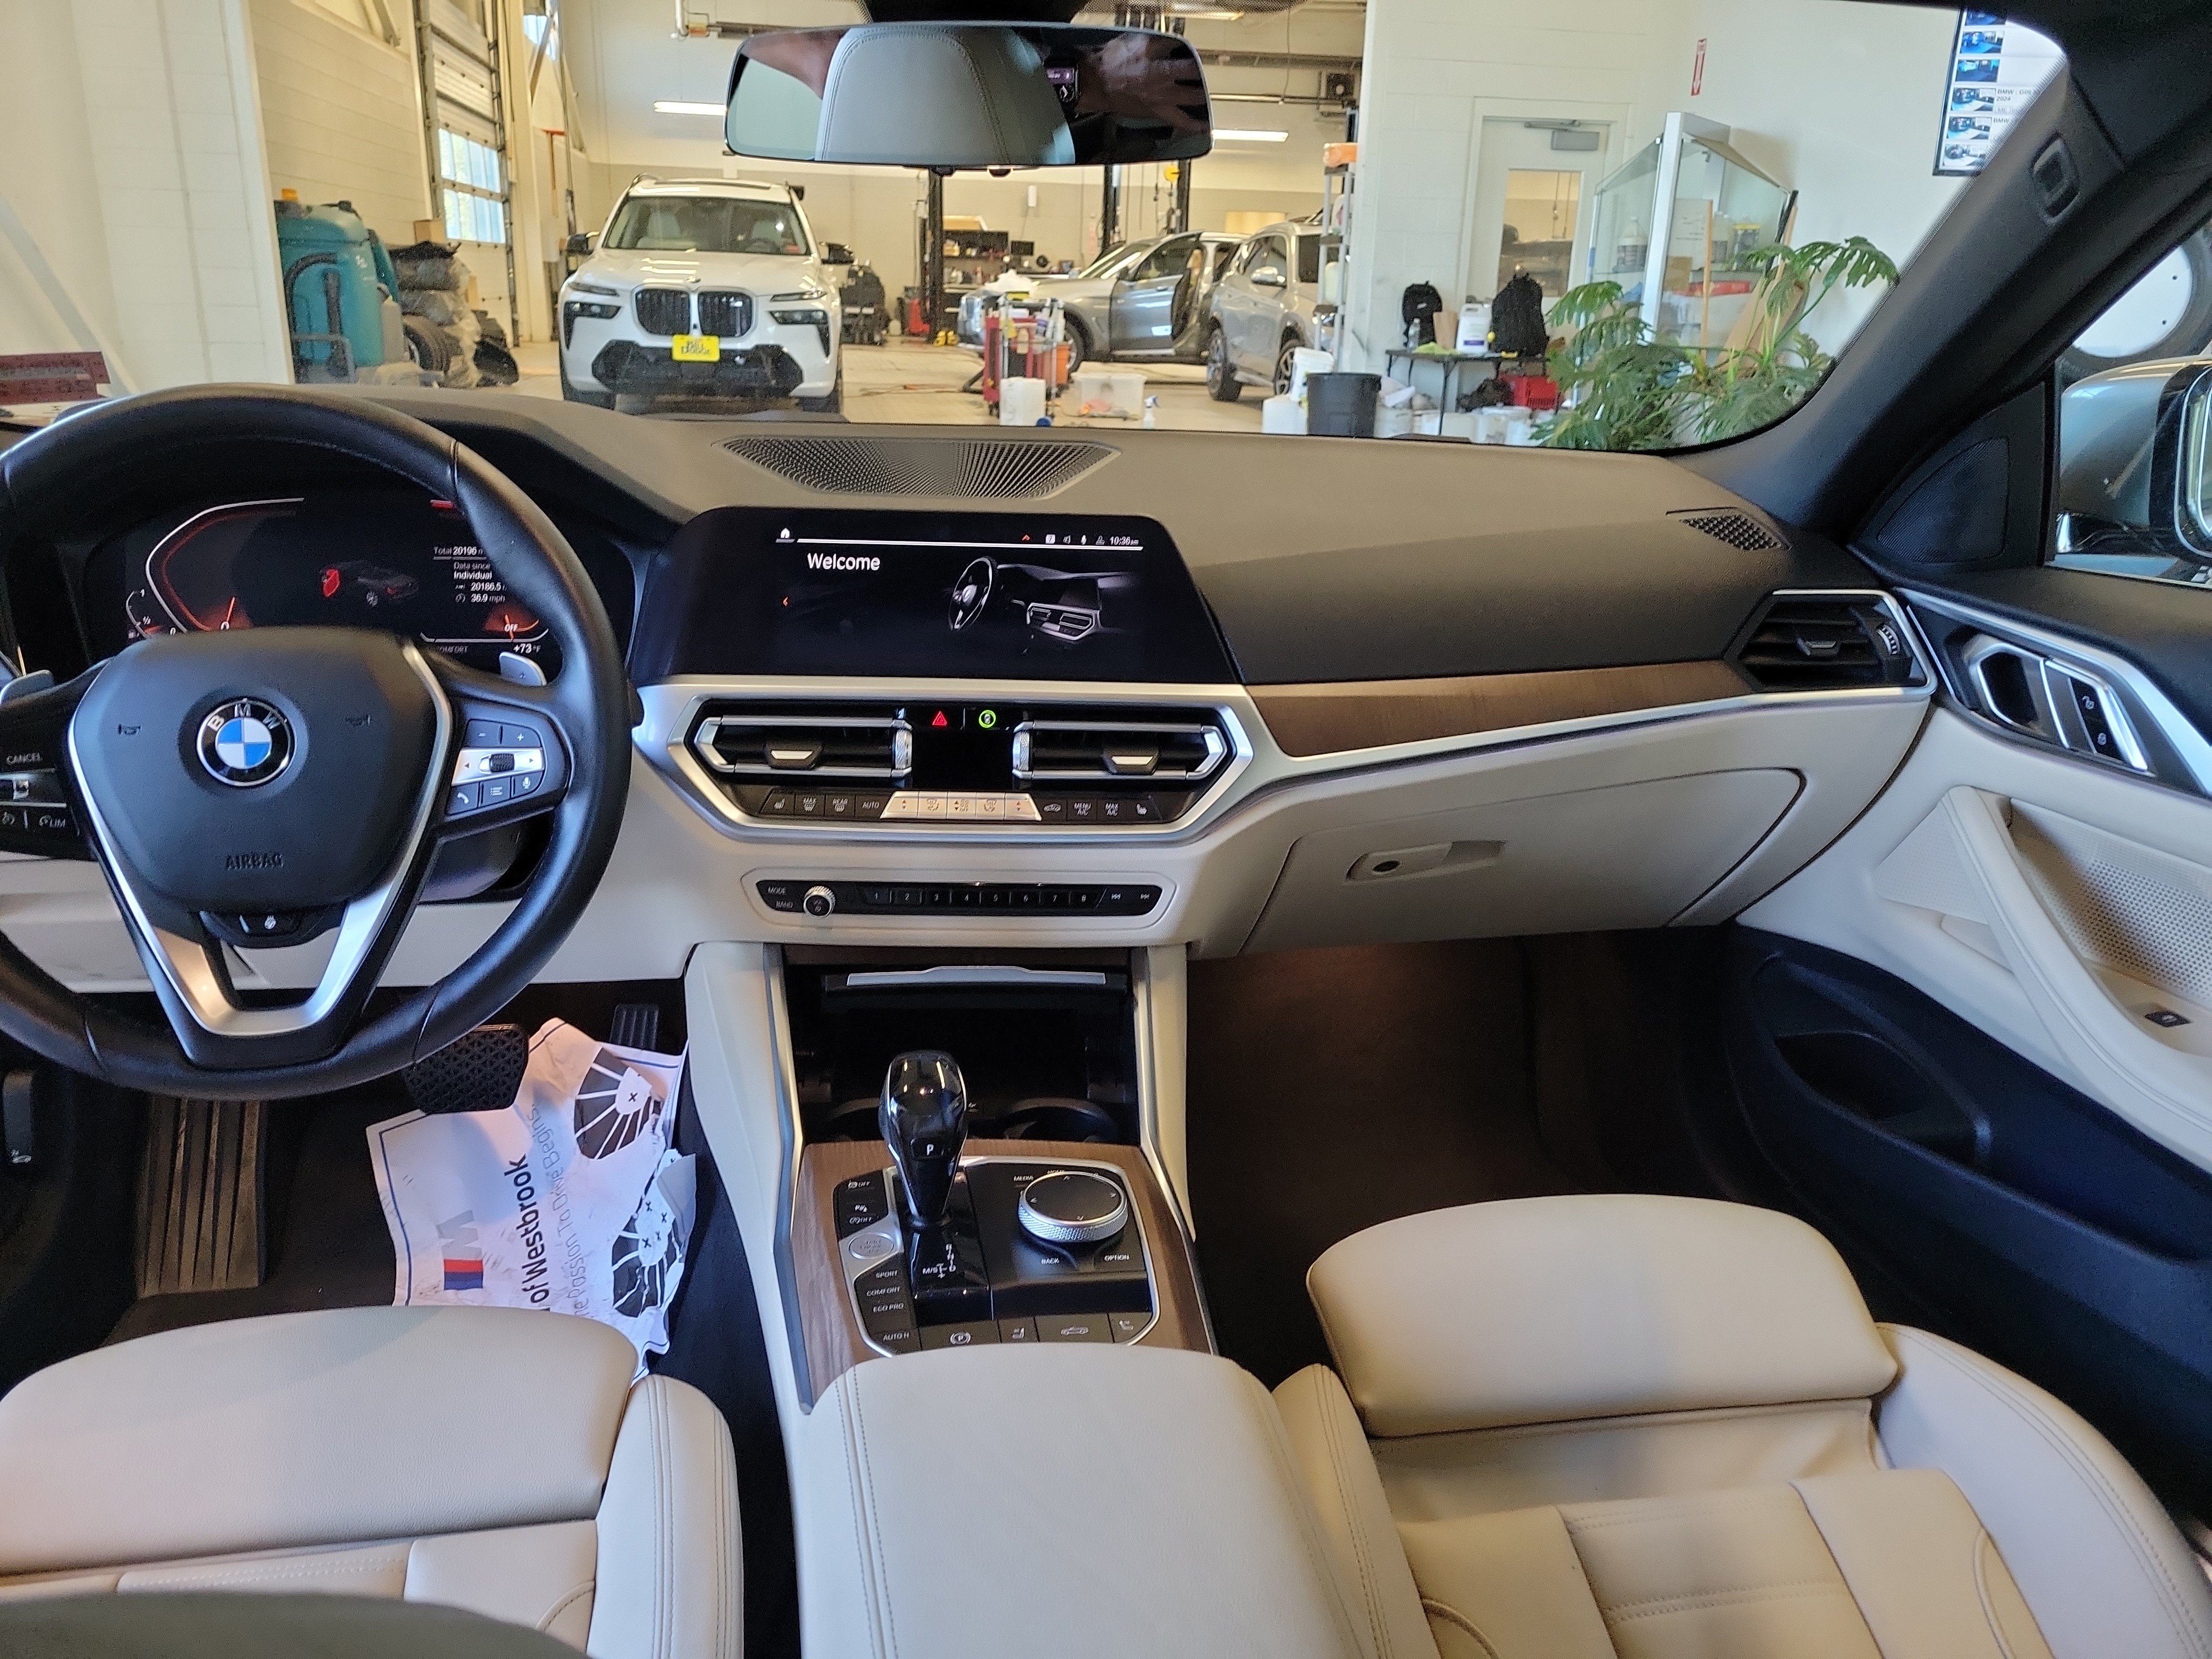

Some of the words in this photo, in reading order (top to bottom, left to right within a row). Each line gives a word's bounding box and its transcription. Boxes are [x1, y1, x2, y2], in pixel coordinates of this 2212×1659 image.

[434, 546, 452, 555] Total
[807, 552, 881, 571] Welcome
[454, 570, 493, 580] Individual
[504, 624, 518, 632] OFF
[207, 703, 281, 732] BMW
[862, 801, 880, 809] AUTO
[49, 819, 66, 828] LIM
[225, 853, 284, 871] AIRBAG
[927, 1144, 934, 1155] P
[550, 1167, 568, 1211] Drive
[504, 1153, 549, 1284] Westbrook
[557, 1209, 573, 1238] To
[566, 1233, 587, 1300] Passion
[876, 1270, 898, 1279] SPORT
[522, 1282, 550, 1304] of
[867, 1286, 900, 1296] COMFORT
[883, 1333, 903, 1341] AUTO
